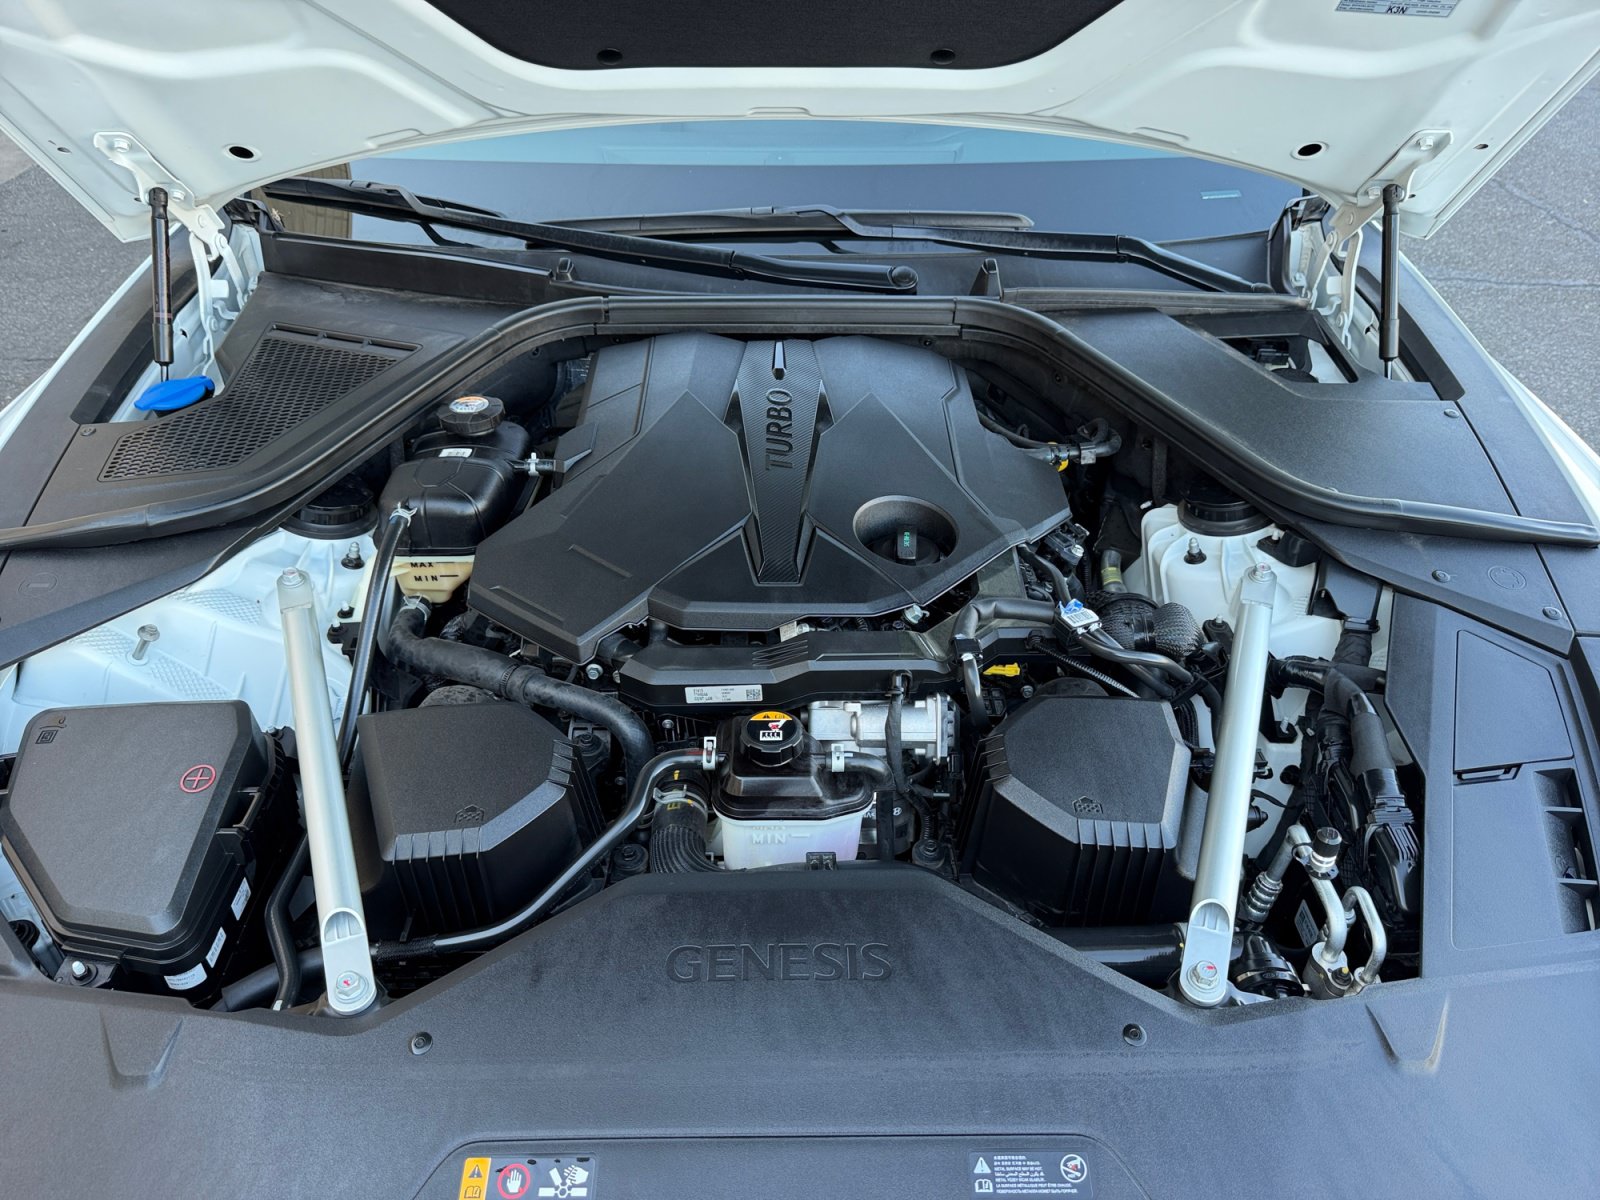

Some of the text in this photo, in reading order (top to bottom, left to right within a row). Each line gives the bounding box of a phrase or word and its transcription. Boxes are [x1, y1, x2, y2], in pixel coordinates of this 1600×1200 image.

[1386, 5, 1408, 15] K3N
[765, 387, 794, 471] TURBO
[752, 832, 787, 845] MIN
[665, 942, 893, 982] GENESIS
